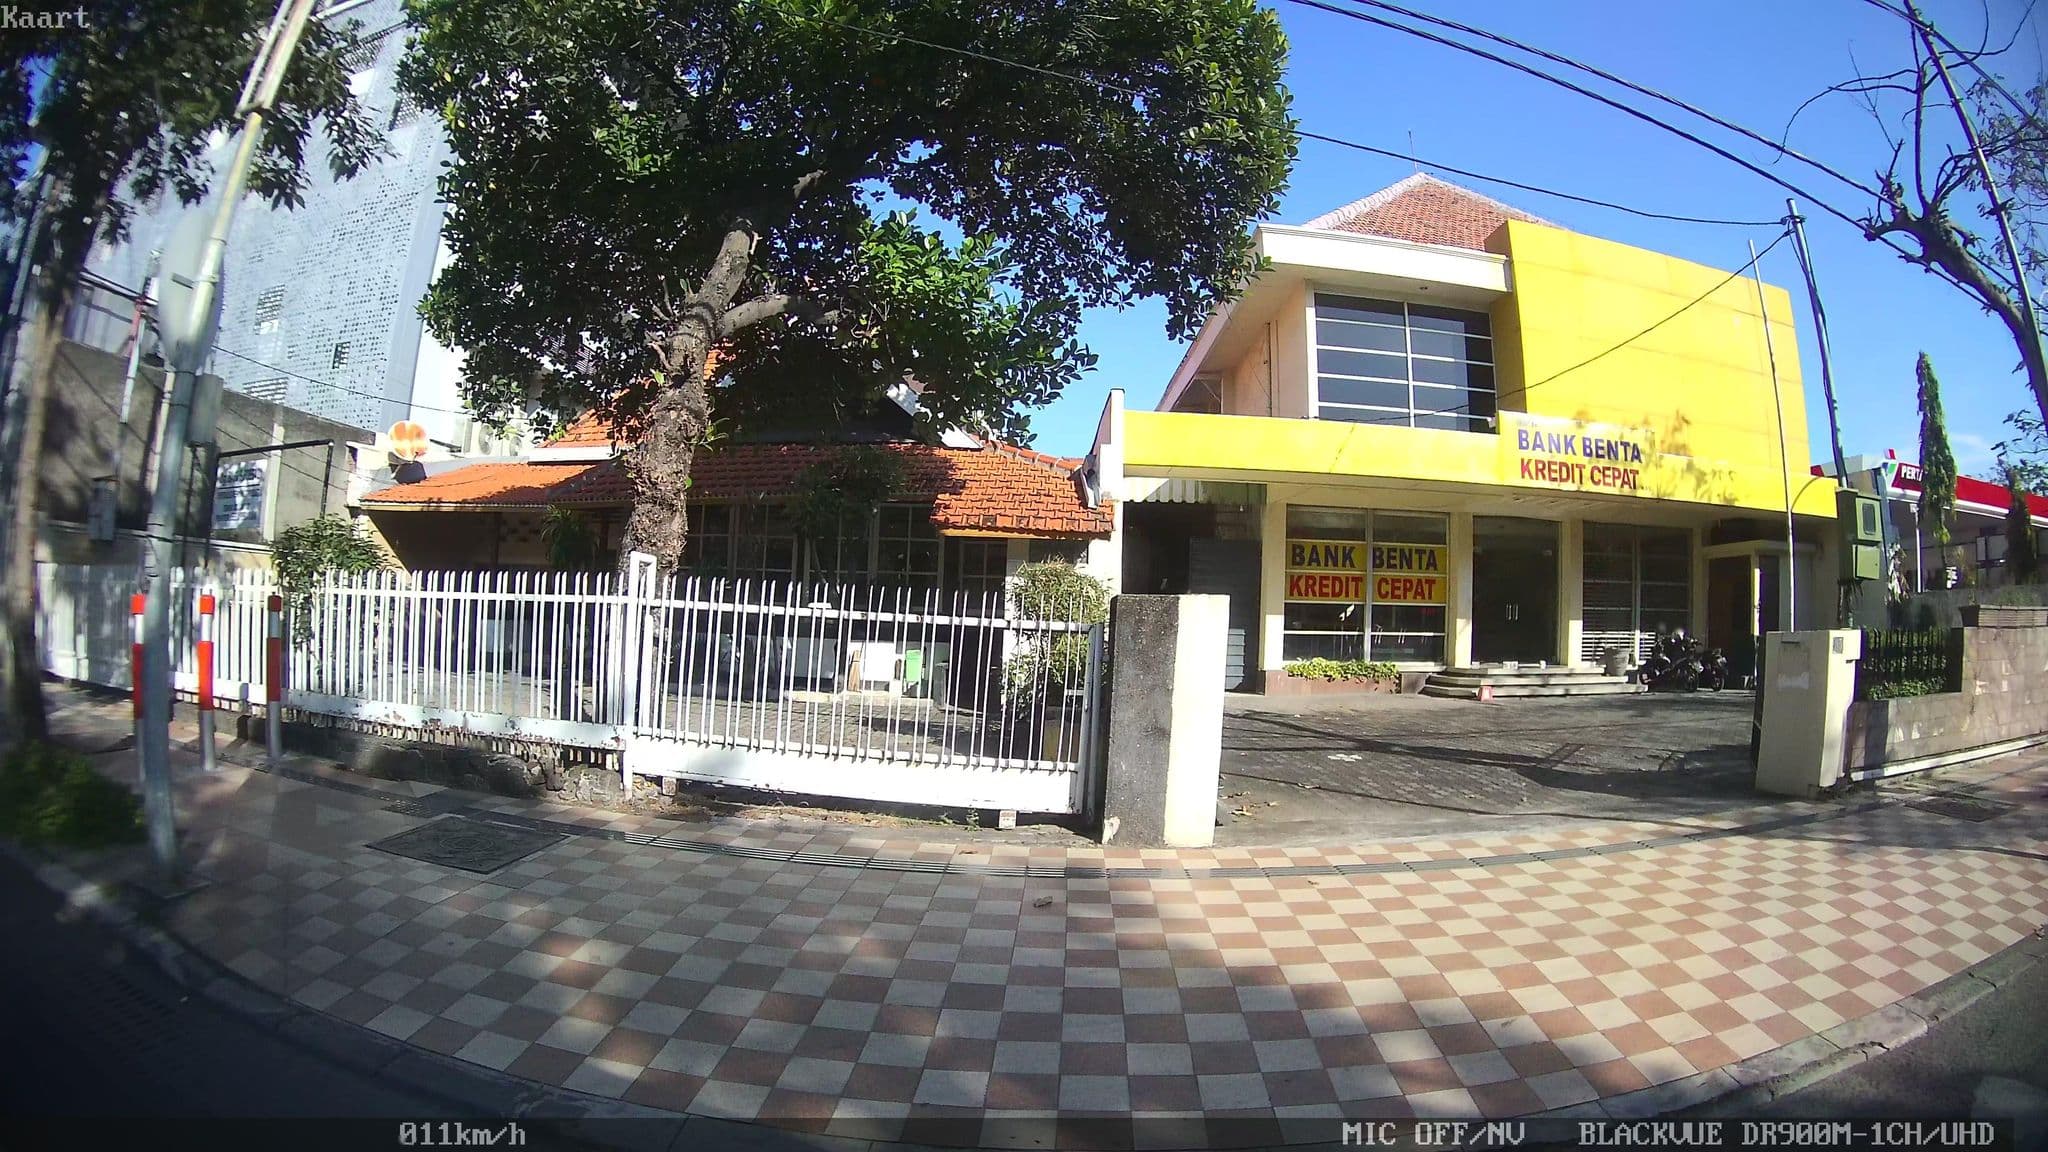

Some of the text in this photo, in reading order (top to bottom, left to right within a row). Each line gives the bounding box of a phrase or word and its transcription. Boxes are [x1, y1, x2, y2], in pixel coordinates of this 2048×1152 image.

[1518, 429, 1643, 464] BANK BENTA
[1520, 458, 1639, 490] KREDIT CEPAT
[1291, 544, 1438, 571] BANK BENTA
[1289, 575, 1436, 600] KREDIT CEPAT
